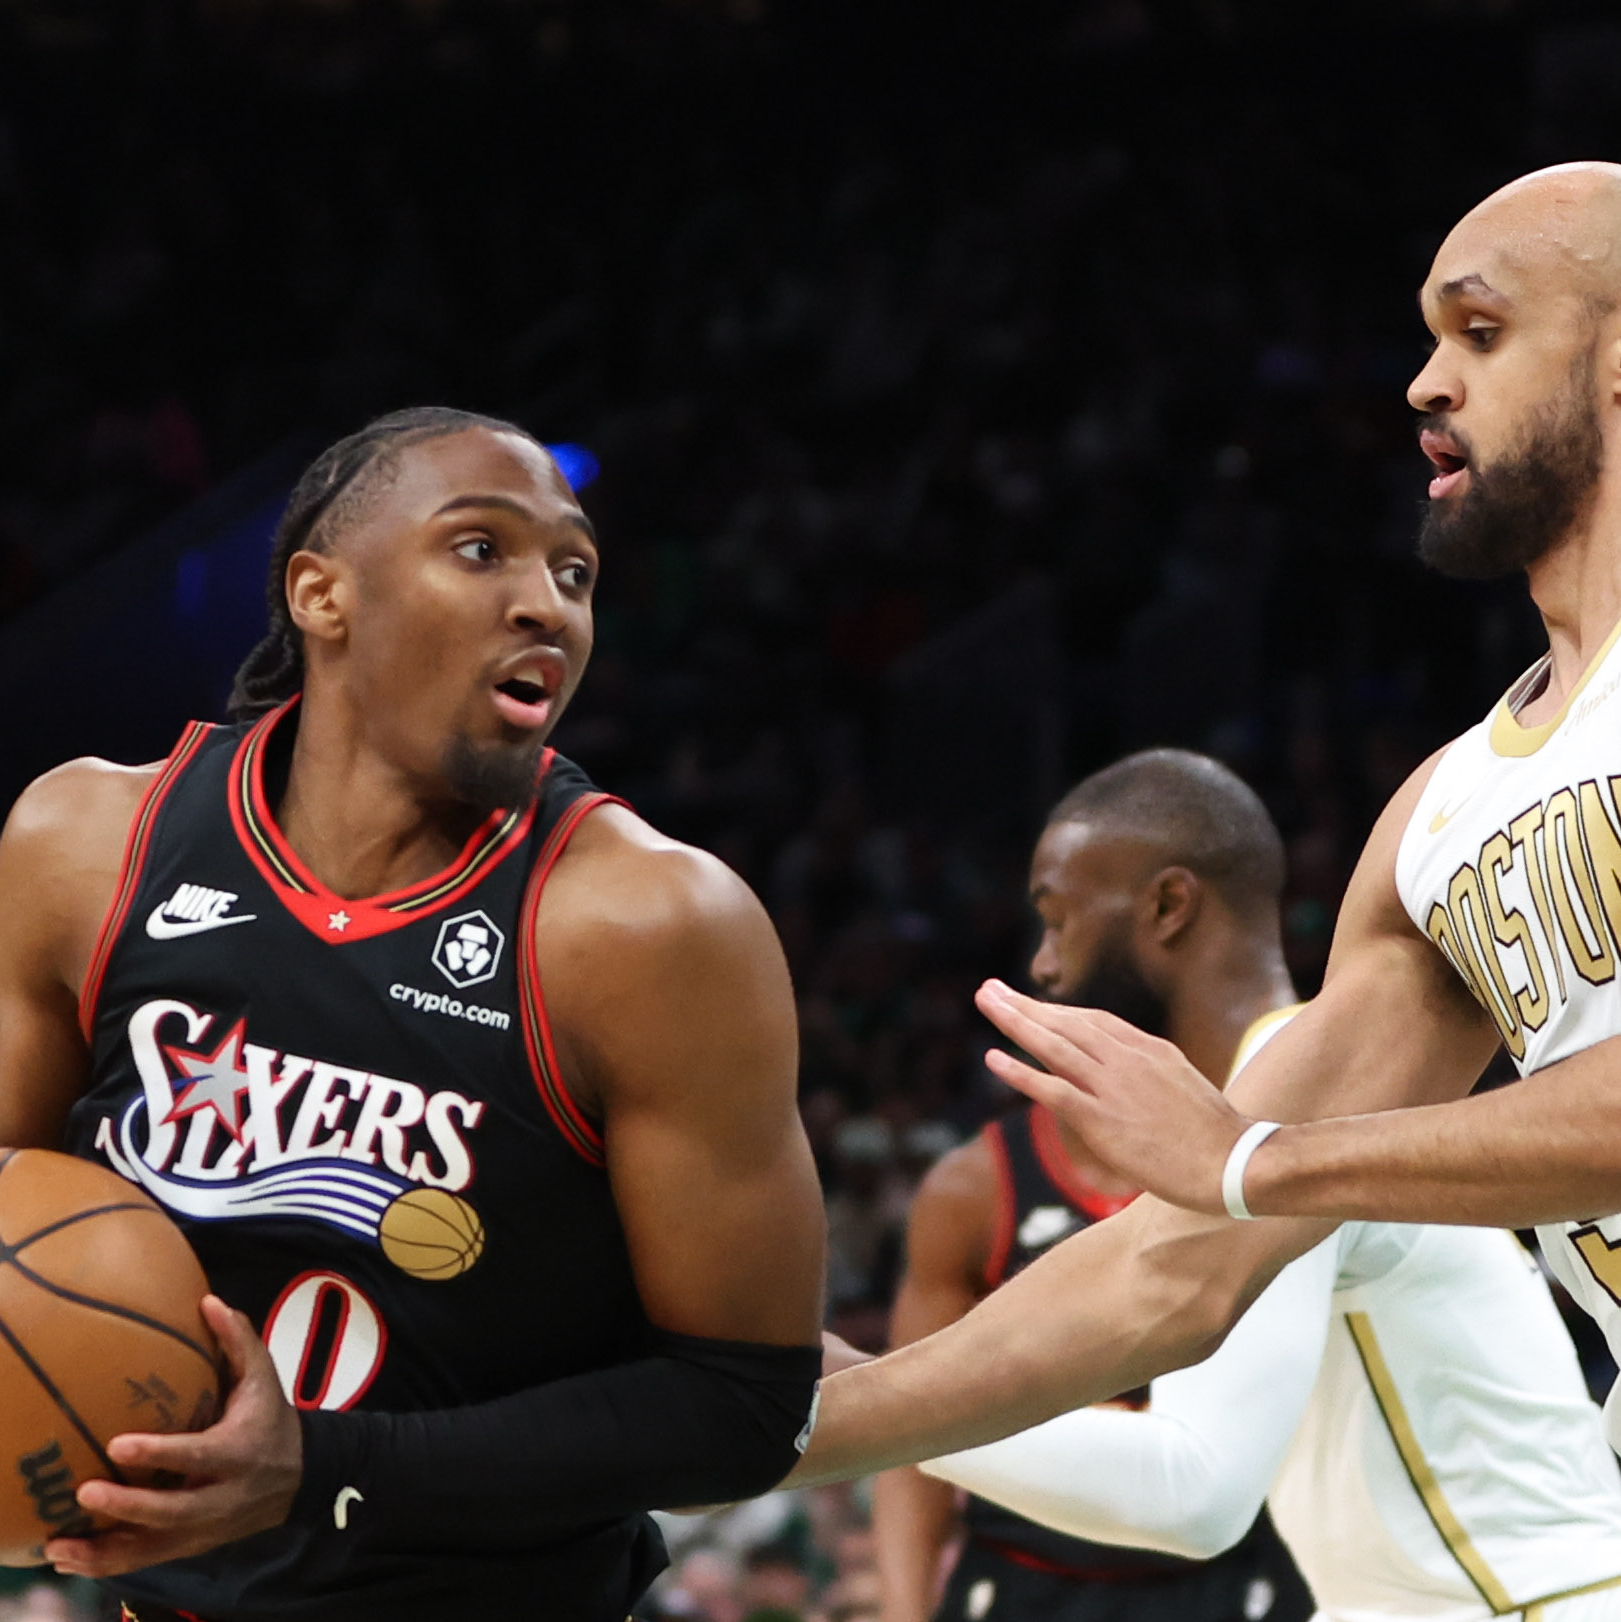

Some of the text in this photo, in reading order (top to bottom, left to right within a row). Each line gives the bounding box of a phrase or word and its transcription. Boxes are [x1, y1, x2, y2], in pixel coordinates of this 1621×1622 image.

[163, 883, 239, 921] NIKE
[389, 983, 511, 1031] crypto.com
[95, 998, 487, 1193] SIXERS
[262, 1269, 389, 1413] 0
